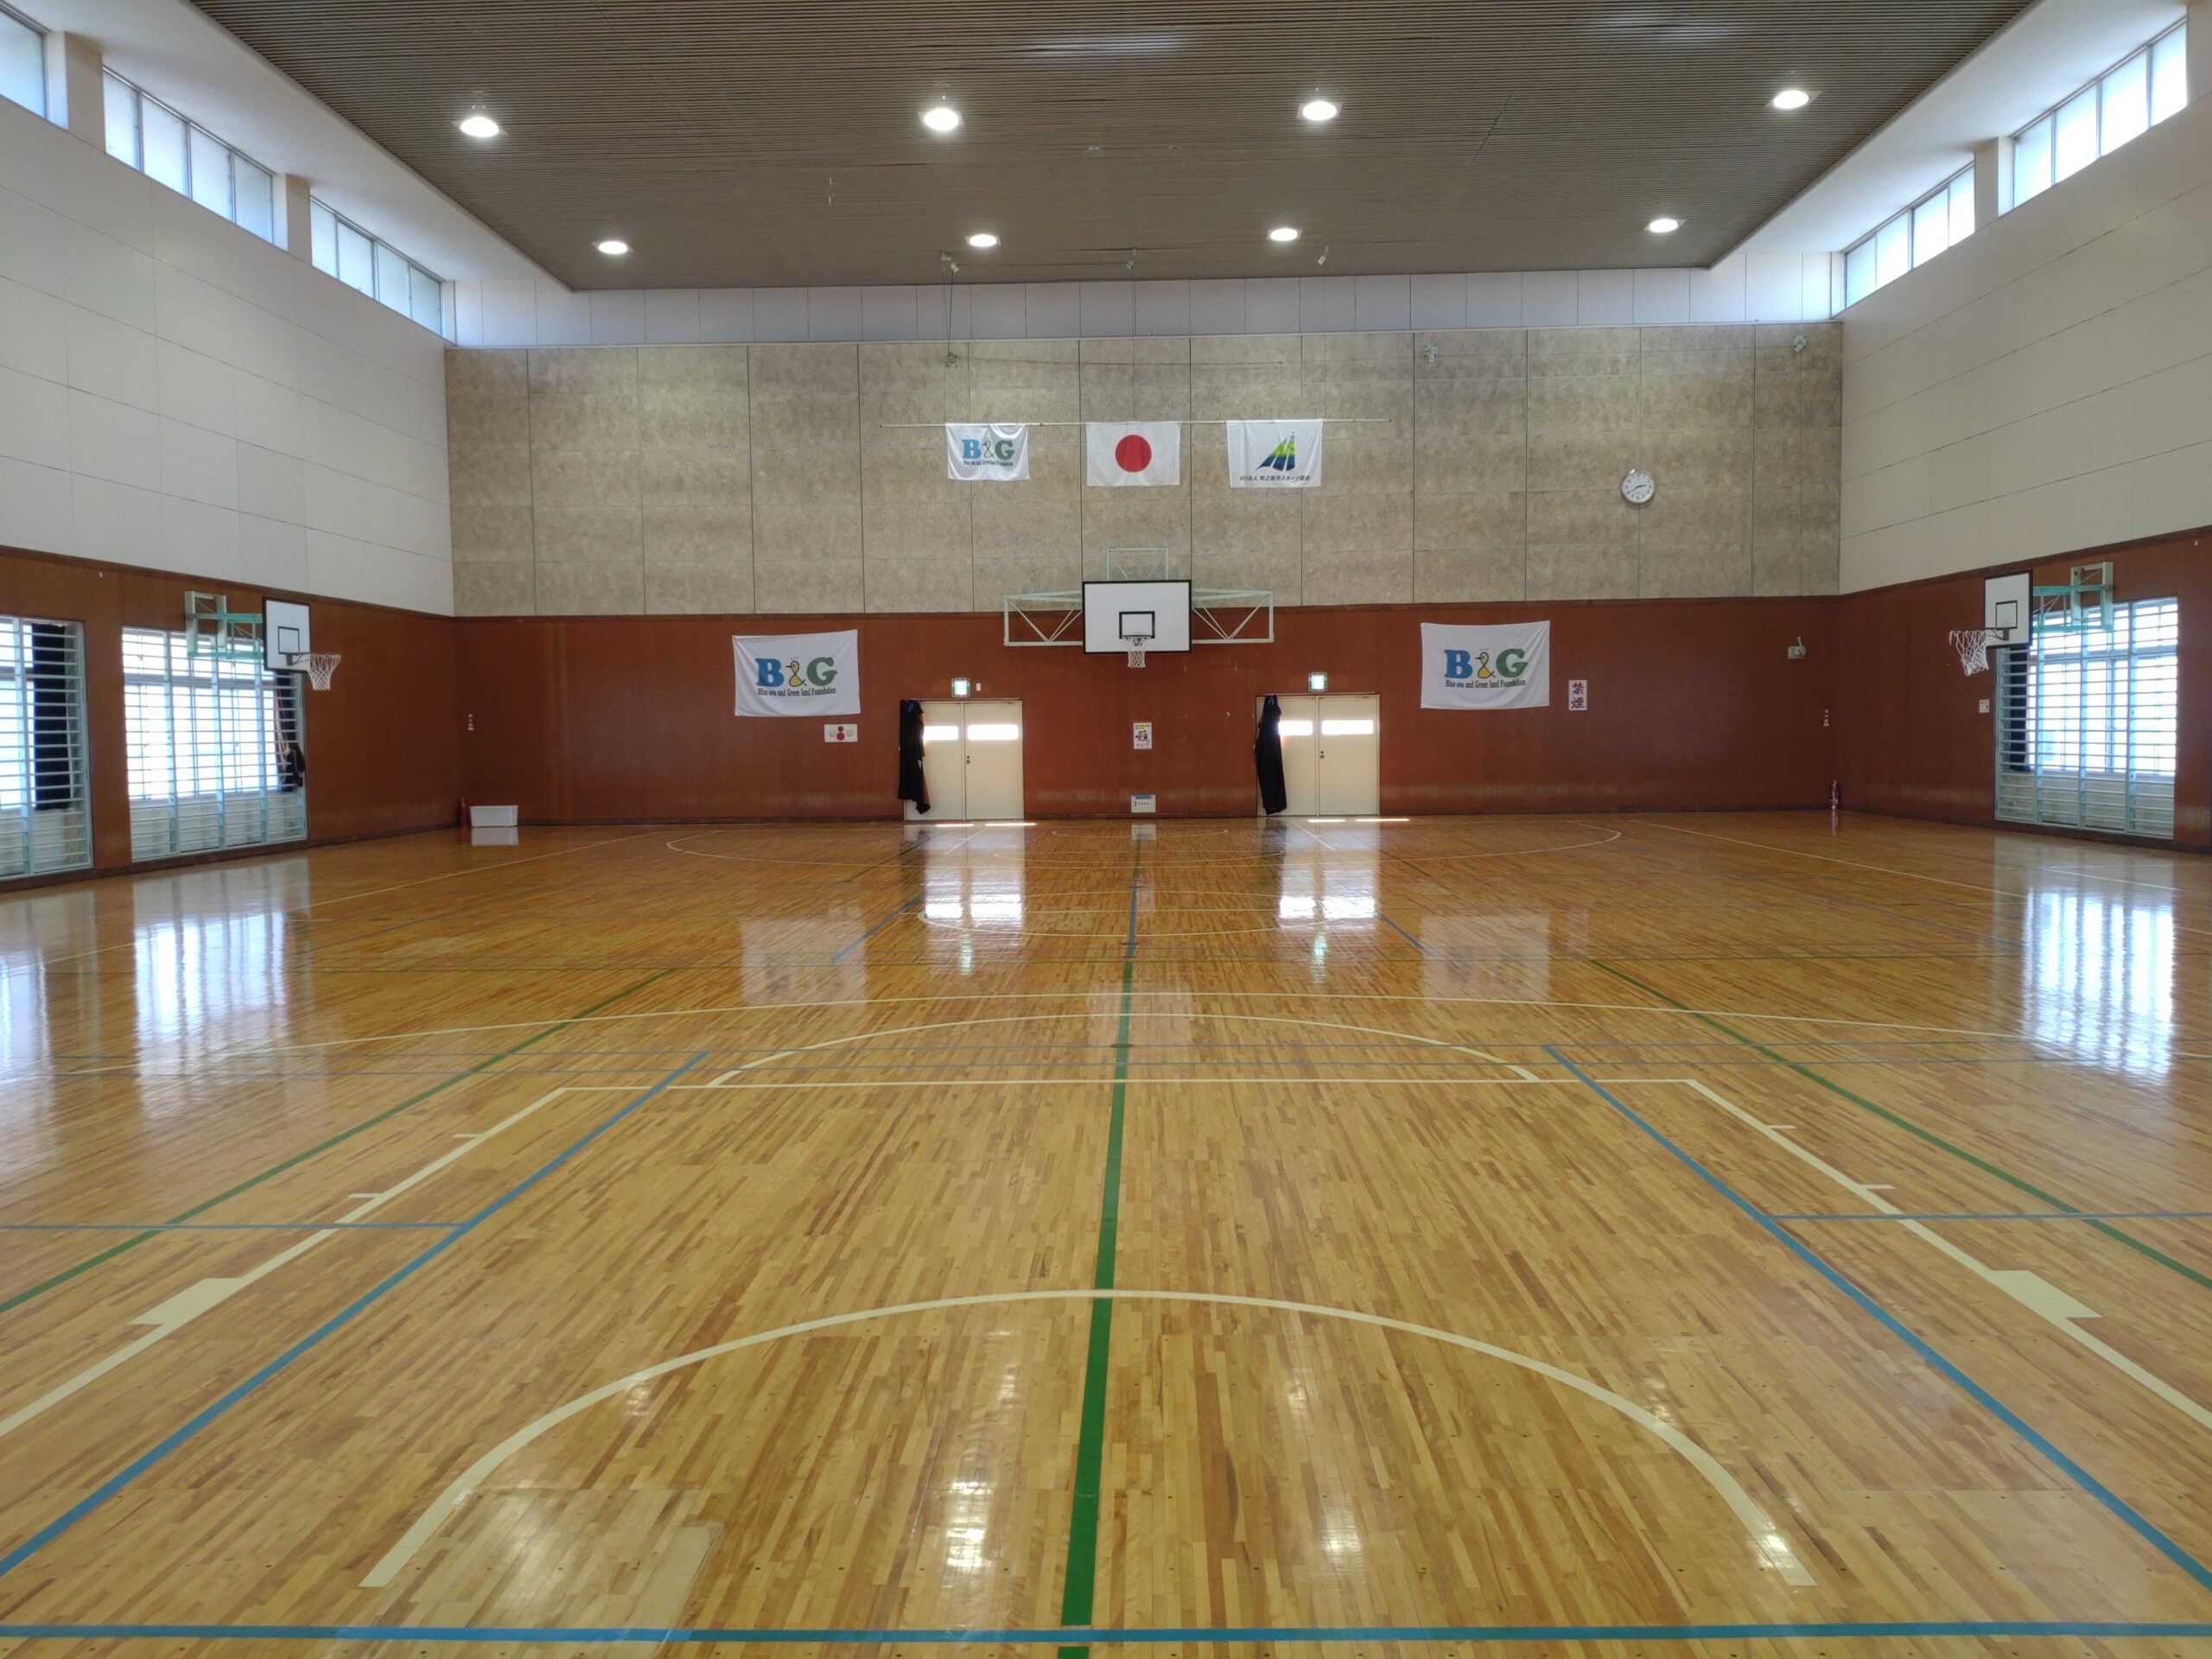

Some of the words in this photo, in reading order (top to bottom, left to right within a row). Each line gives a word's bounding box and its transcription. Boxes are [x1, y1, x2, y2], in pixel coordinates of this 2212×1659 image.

[962, 439, 1015, 460] B&G
[755, 657, 838, 687] B&G
[1444, 648, 1529, 679] B&G
[811, 687, 836, 696] Foundation
[1446, 679, 1456, 688] Blue
[1570, 681, 1585, 709] 禁煙
